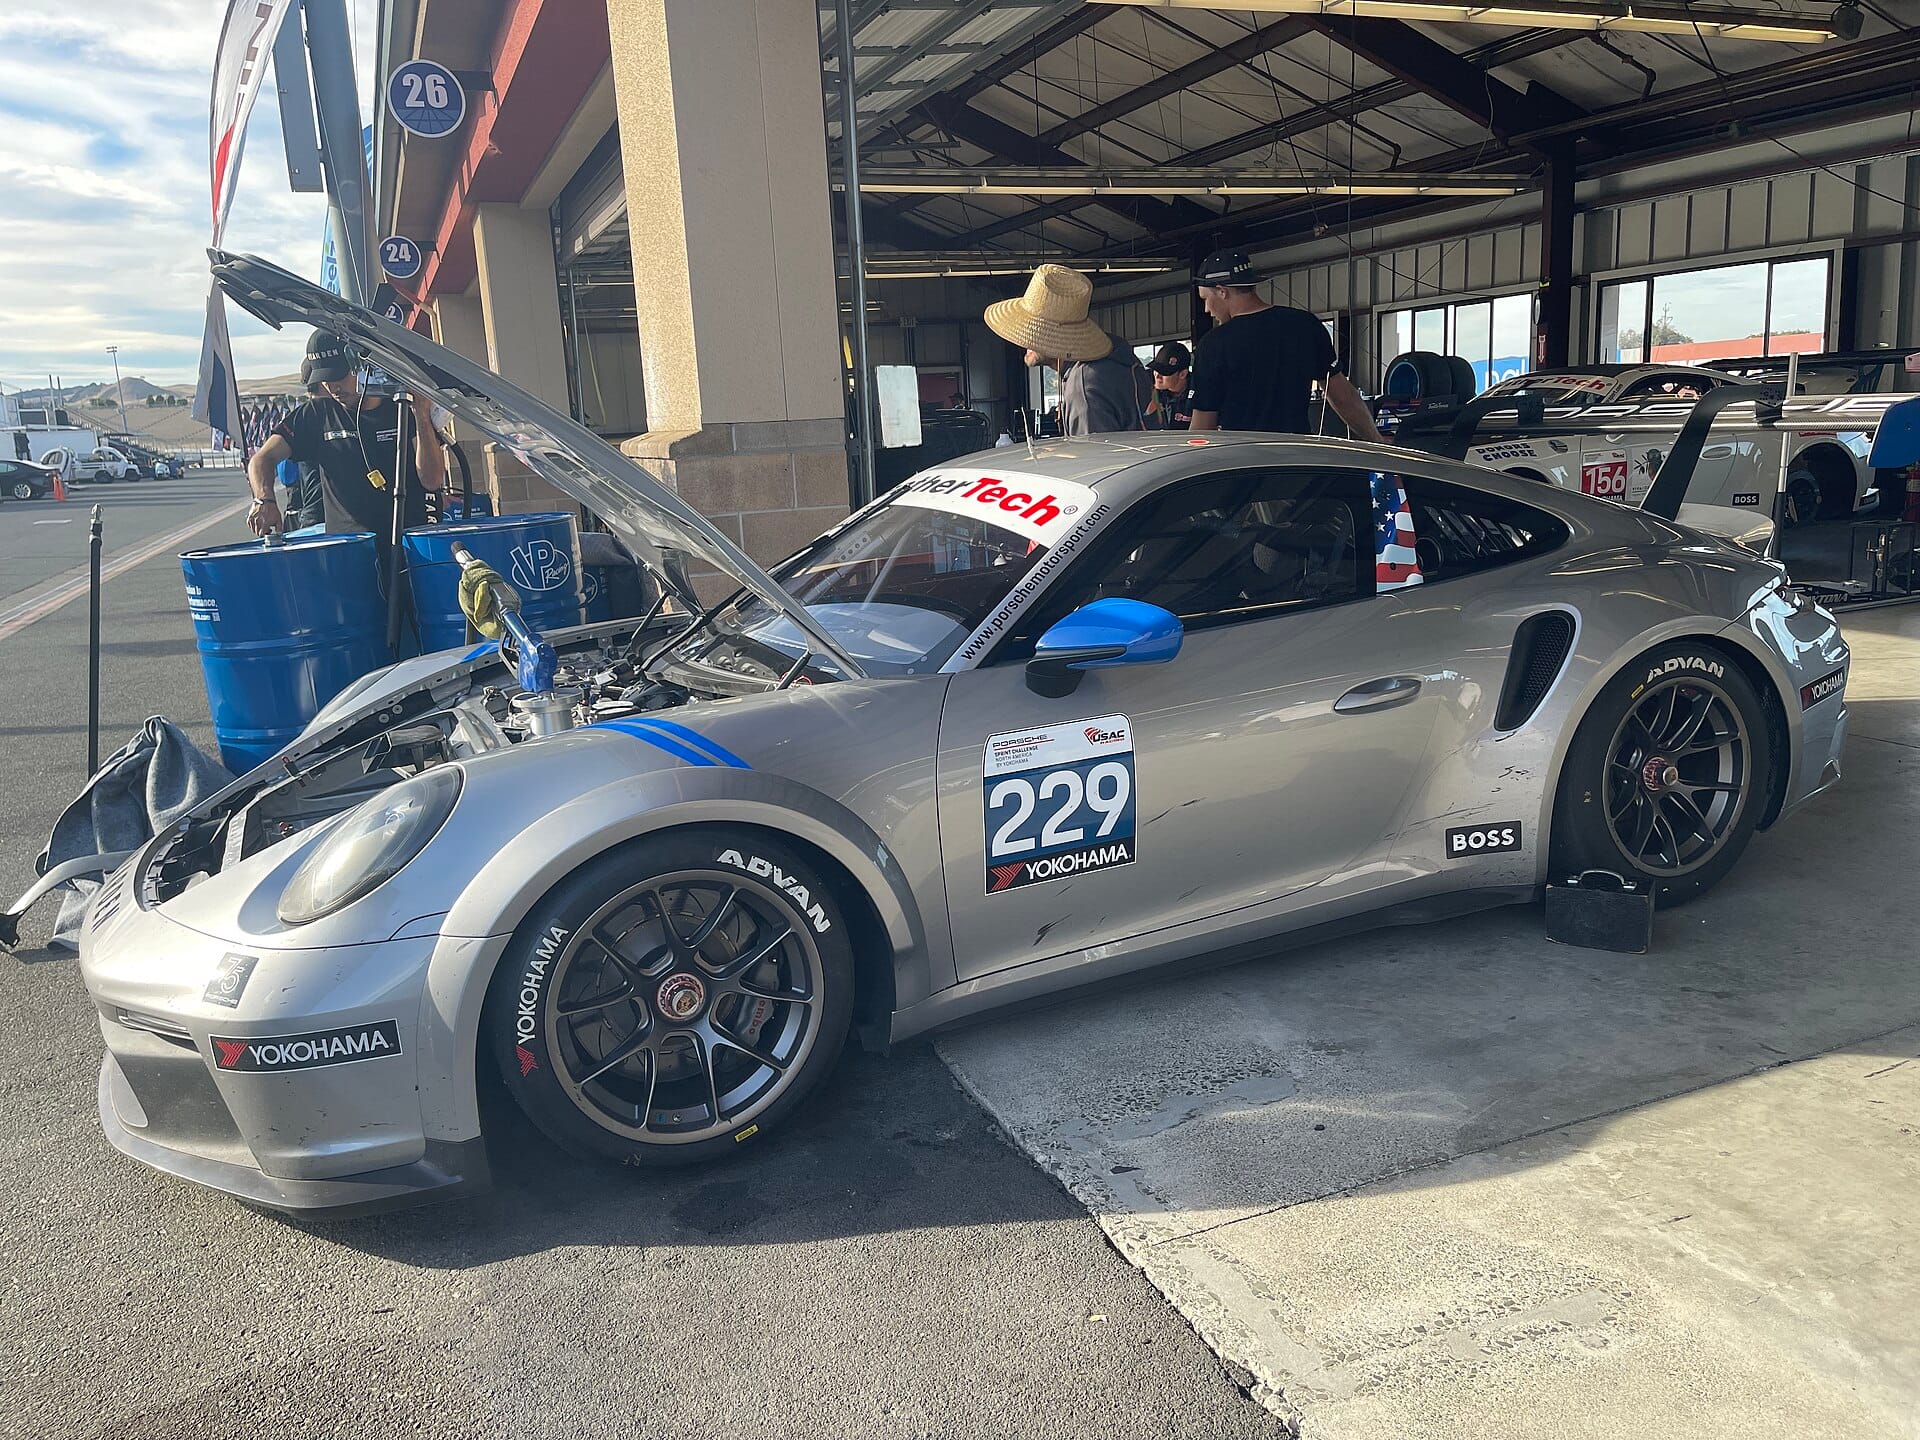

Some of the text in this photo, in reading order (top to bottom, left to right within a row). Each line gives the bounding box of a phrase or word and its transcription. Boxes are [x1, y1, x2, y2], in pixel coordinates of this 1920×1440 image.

[402, 73, 448, 109] 26
[386, 243, 412, 263] 24
[384, 305, 397, 319] 2
[1483, 449, 1537, 462] CHOOSE
[1586, 465, 1626, 496] 156
[912, 475, 1061, 527] therTech
[1734, 495, 1757, 504] BOSS
[510, 540, 556, 590] VP
[961, 502, 1111, 661] www.porschemotorsport.com
[1646, 657, 1725, 683] ADVAN
[1811, 672, 1844, 700] YOKOHAMA
[992, 734, 1048, 748] PORSCHE
[1093, 730, 1125, 742] USAC
[994, 745, 1039, 757] SPRINT CHALLENGE
[996, 752, 1032, 762] NORTH AMERICA
[1003, 758, 1028, 767] YOKOHAMA
[989, 762, 1131, 858] 229
[1452, 828, 1515, 852] BOSS
[1025, 844, 1129, 880] YOKOHAMA
[716, 848, 833, 934] ADVAN
[516, 924, 569, 1046] YOKOHAMA
[249, 1029, 390, 1065] YOKOHAMA
